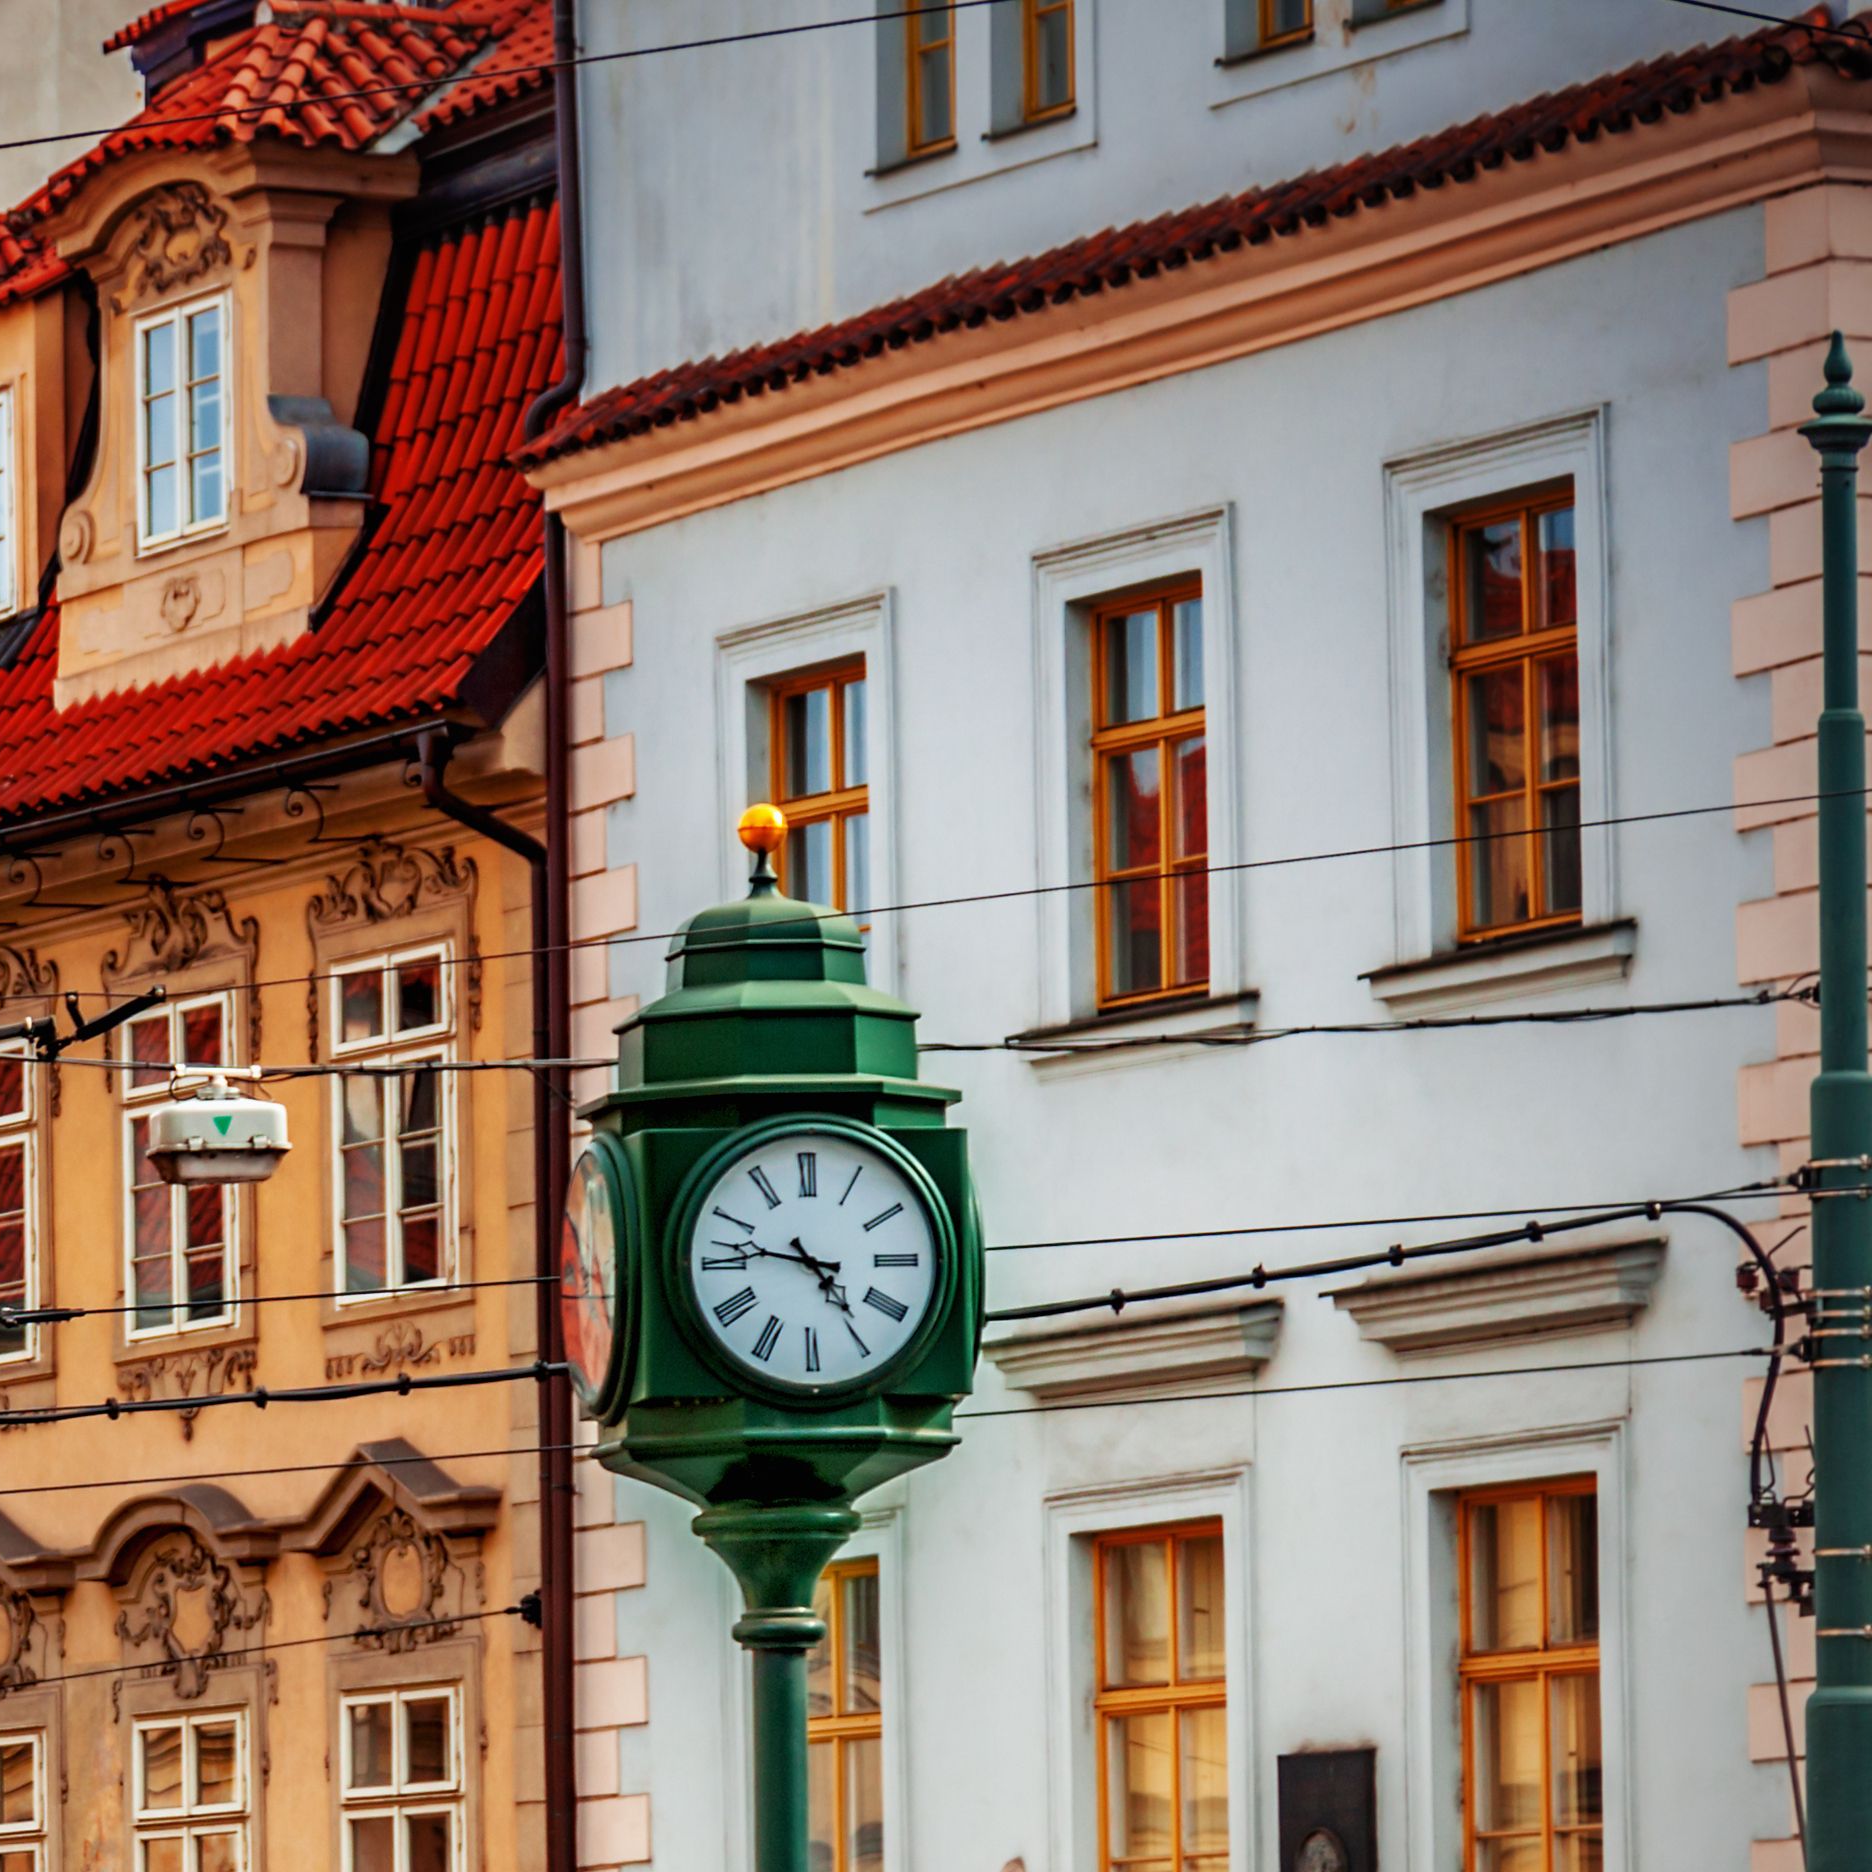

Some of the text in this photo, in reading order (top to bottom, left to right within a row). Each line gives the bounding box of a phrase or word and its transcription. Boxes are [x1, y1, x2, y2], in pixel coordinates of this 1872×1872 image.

[748, 1165, 782, 1210] XI
[797, 1152, 817, 1198] XII
[839, 1165, 862, 1206] I
[863, 1202, 904, 1232] II
[874, 1253, 918, 1267] III
[713, 1286, 760, 1328] VIII
[751, 1315, 785, 1362] VII
[805, 1327, 821, 1372] VI
